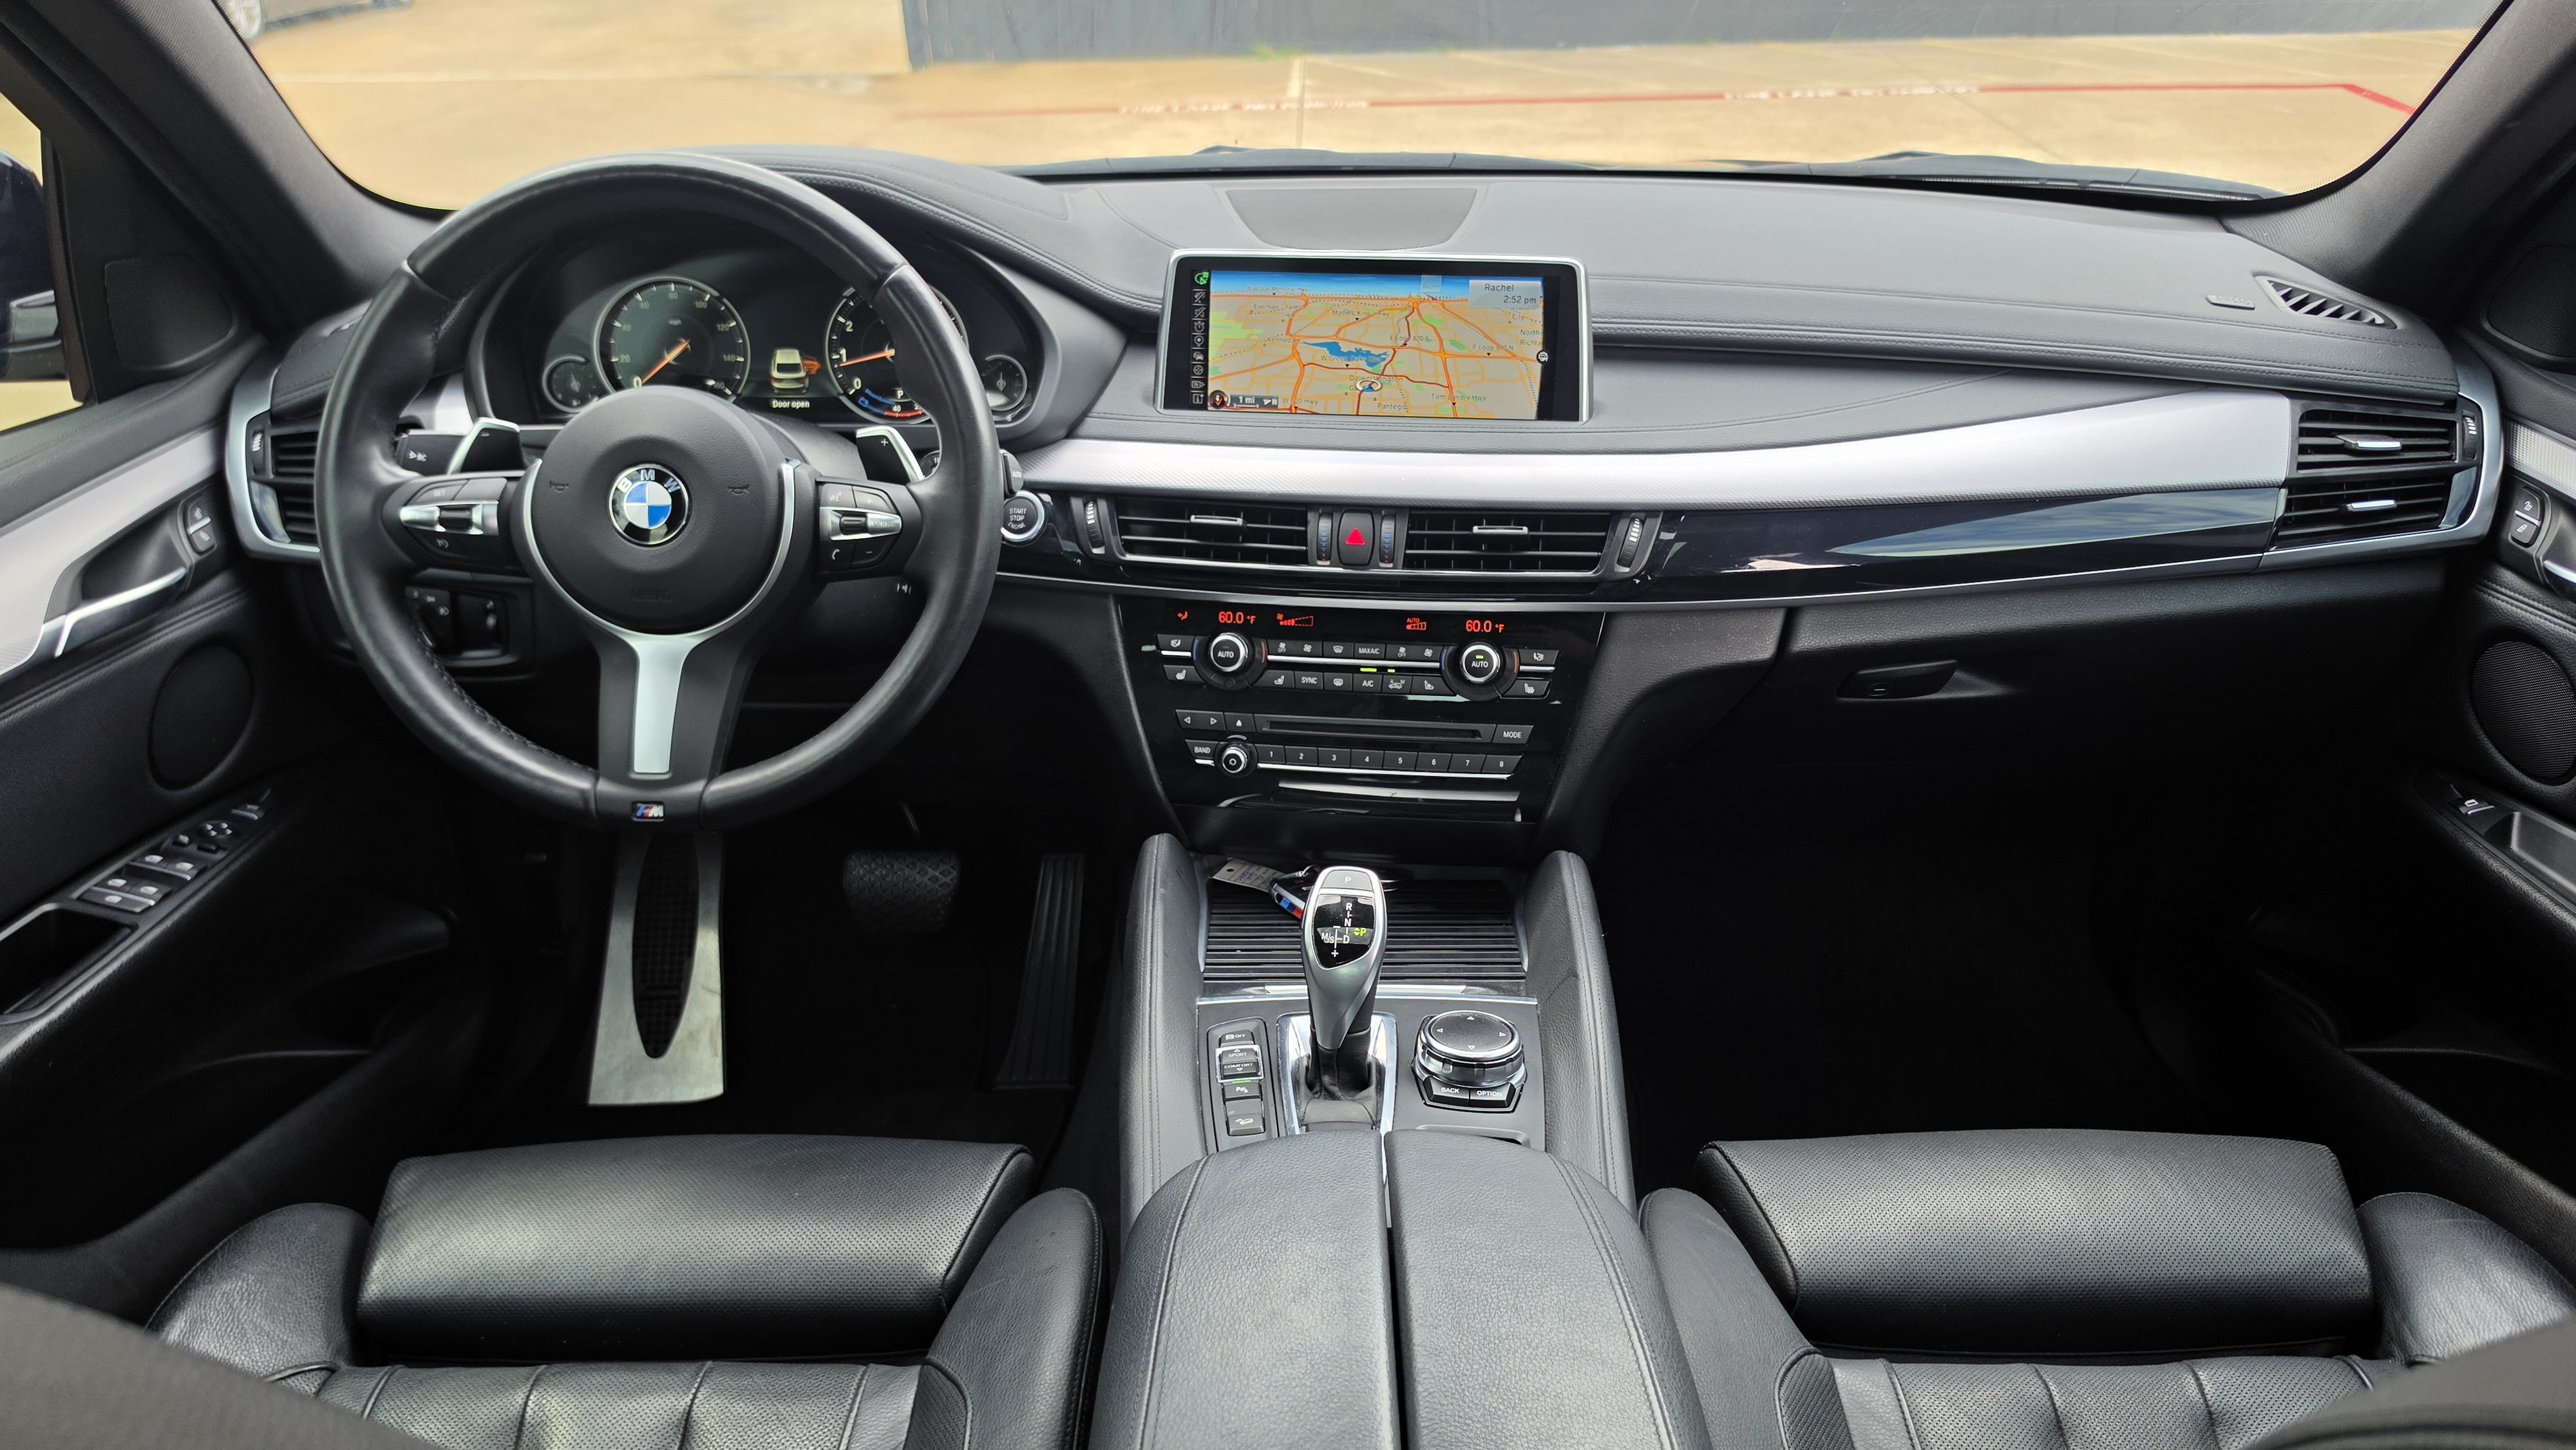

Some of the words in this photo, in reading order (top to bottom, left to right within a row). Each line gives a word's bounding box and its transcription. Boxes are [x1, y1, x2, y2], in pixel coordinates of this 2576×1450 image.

[1484, 283, 1513, 292] Rachel
[1504, 296, 1522, 304] 2:52
[846, 321, 853, 332] 2
[839, 348, 847, 362] 1
[633, 376, 642, 387] 0
[854, 377, 862, 390] 0
[898, 390, 904, 399] P
[773, 399, 790, 408] Door
[791, 400, 810, 410] open
[617, 469, 681, 493] BMW
[1007, 522, 1027, 530] ENGINE
[1218, 611, 1244, 624] 60.0
[1466, 620, 1492, 632] 60.0
[1344, 918, 1352, 927] N
[1360, 928, 1367, 936] P
[1343, 935, 1350, 943] D
